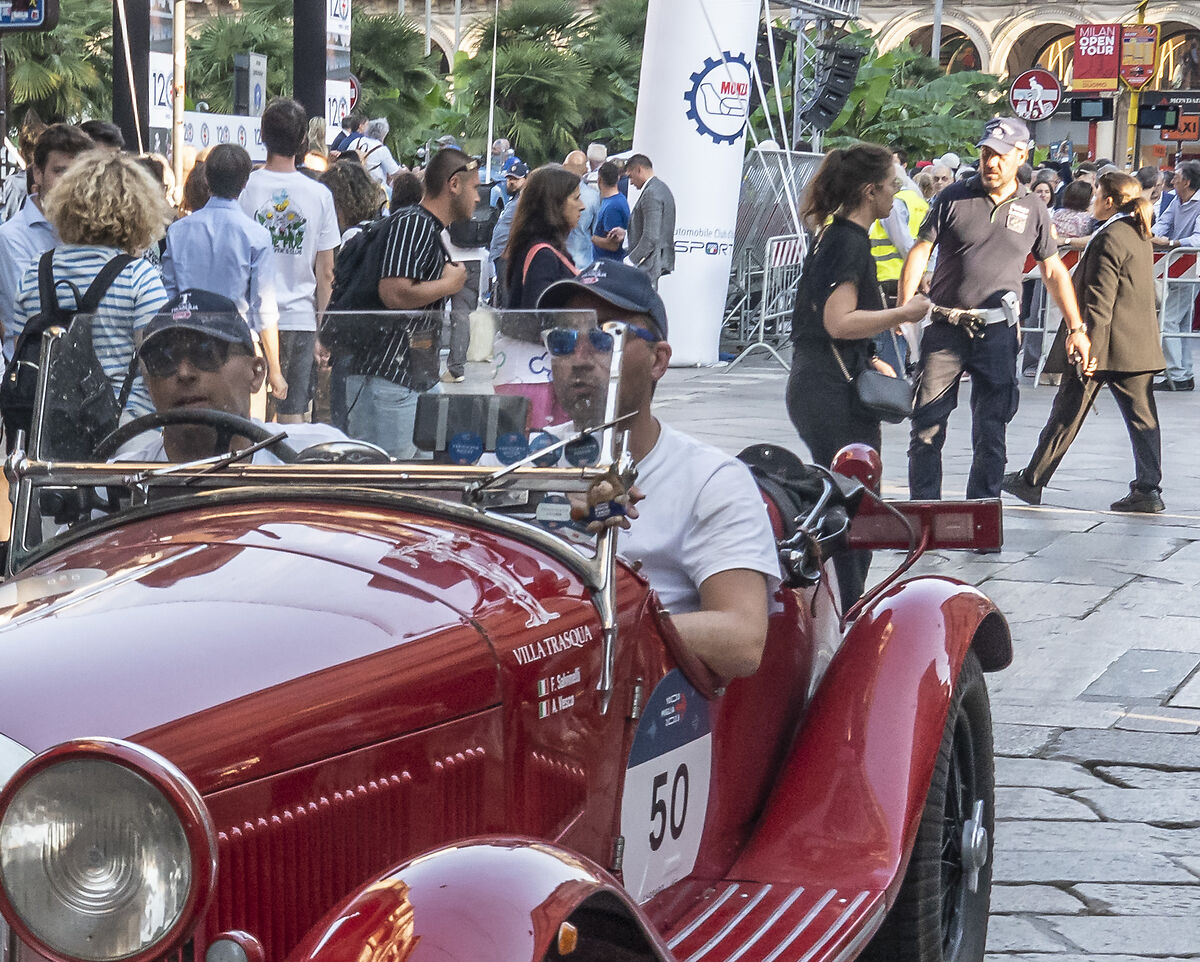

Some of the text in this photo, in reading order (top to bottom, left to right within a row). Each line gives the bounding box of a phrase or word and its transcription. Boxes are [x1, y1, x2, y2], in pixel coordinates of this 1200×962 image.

[1080, 26, 1115, 37] MILAN
[1080, 36, 1115, 46] OPEN
[1080, 46, 1114, 56] TOUR
[513, 625, 593, 665] VILLA TRASQUA
[649, 763, 689, 851] 50
